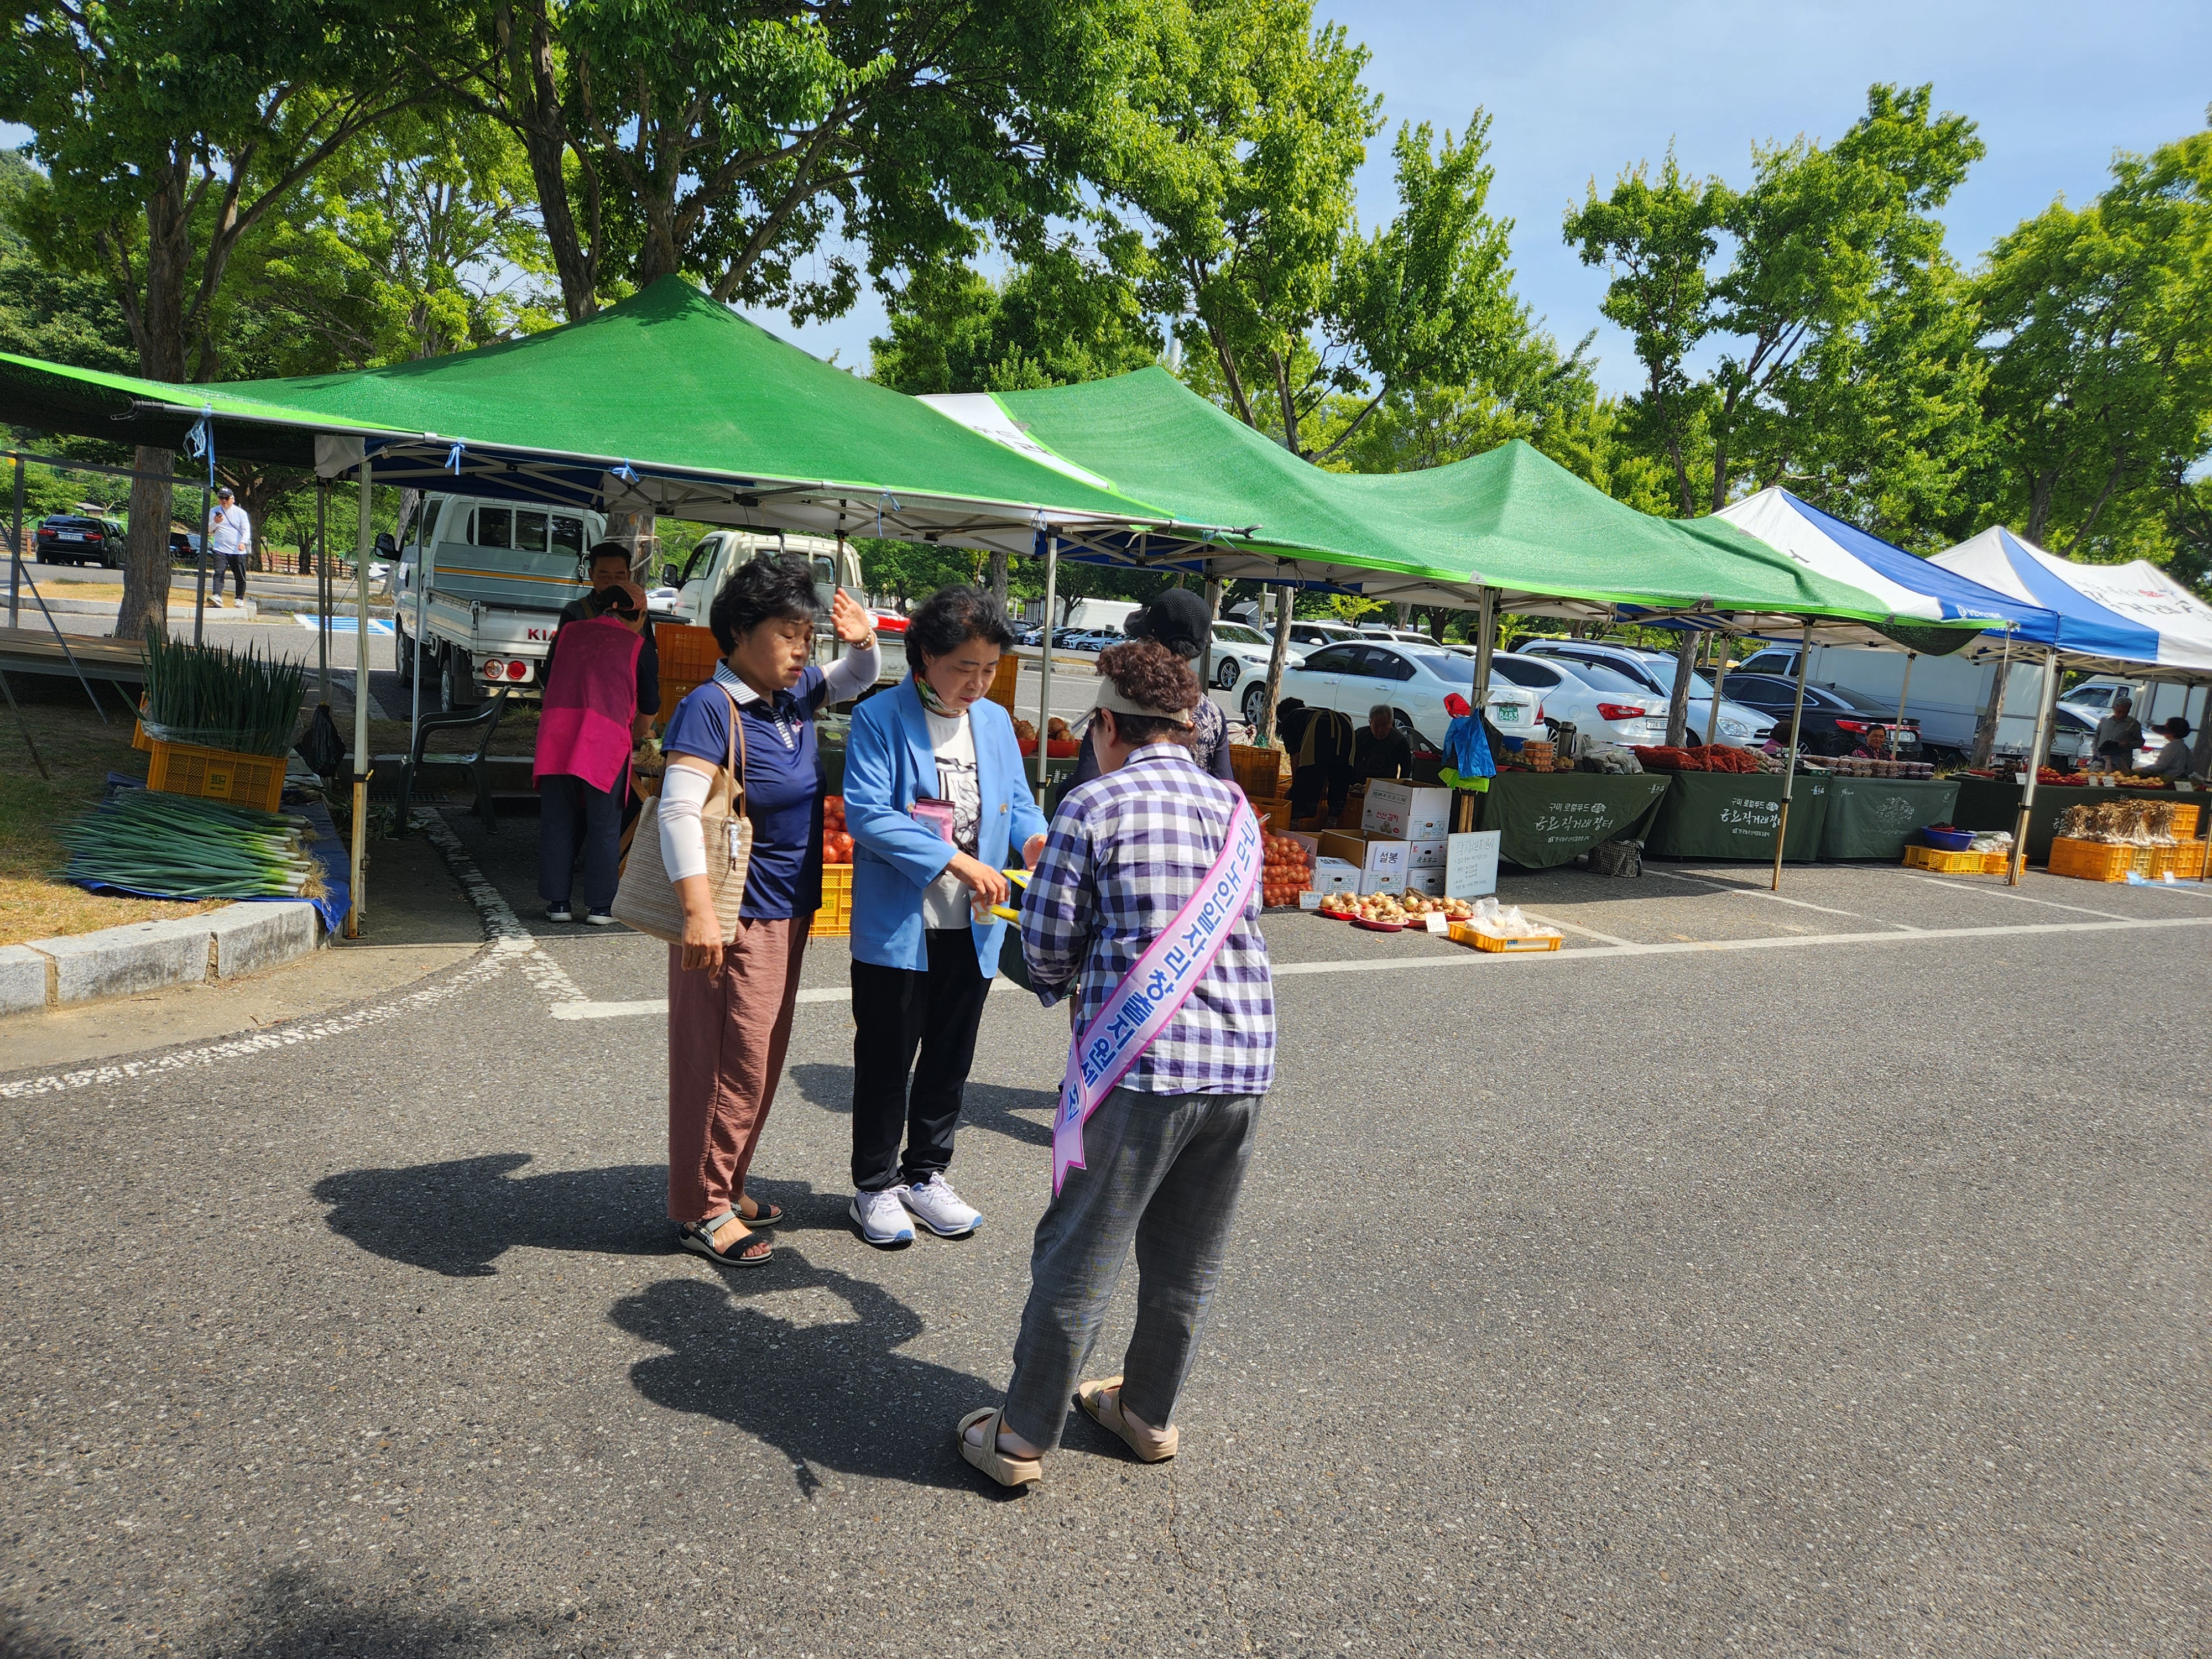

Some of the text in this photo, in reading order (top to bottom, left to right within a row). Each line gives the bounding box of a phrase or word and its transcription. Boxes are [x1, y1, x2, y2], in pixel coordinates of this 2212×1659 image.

[1499, 711, 1518, 721] 8483
[1549, 803, 1590, 812] 구미 로컬푸드
[1731, 797, 1766, 809] 구미 로컬푸드
[1376, 811, 1387, 820] 선산
[1379, 851, 1399, 864] 설봉
